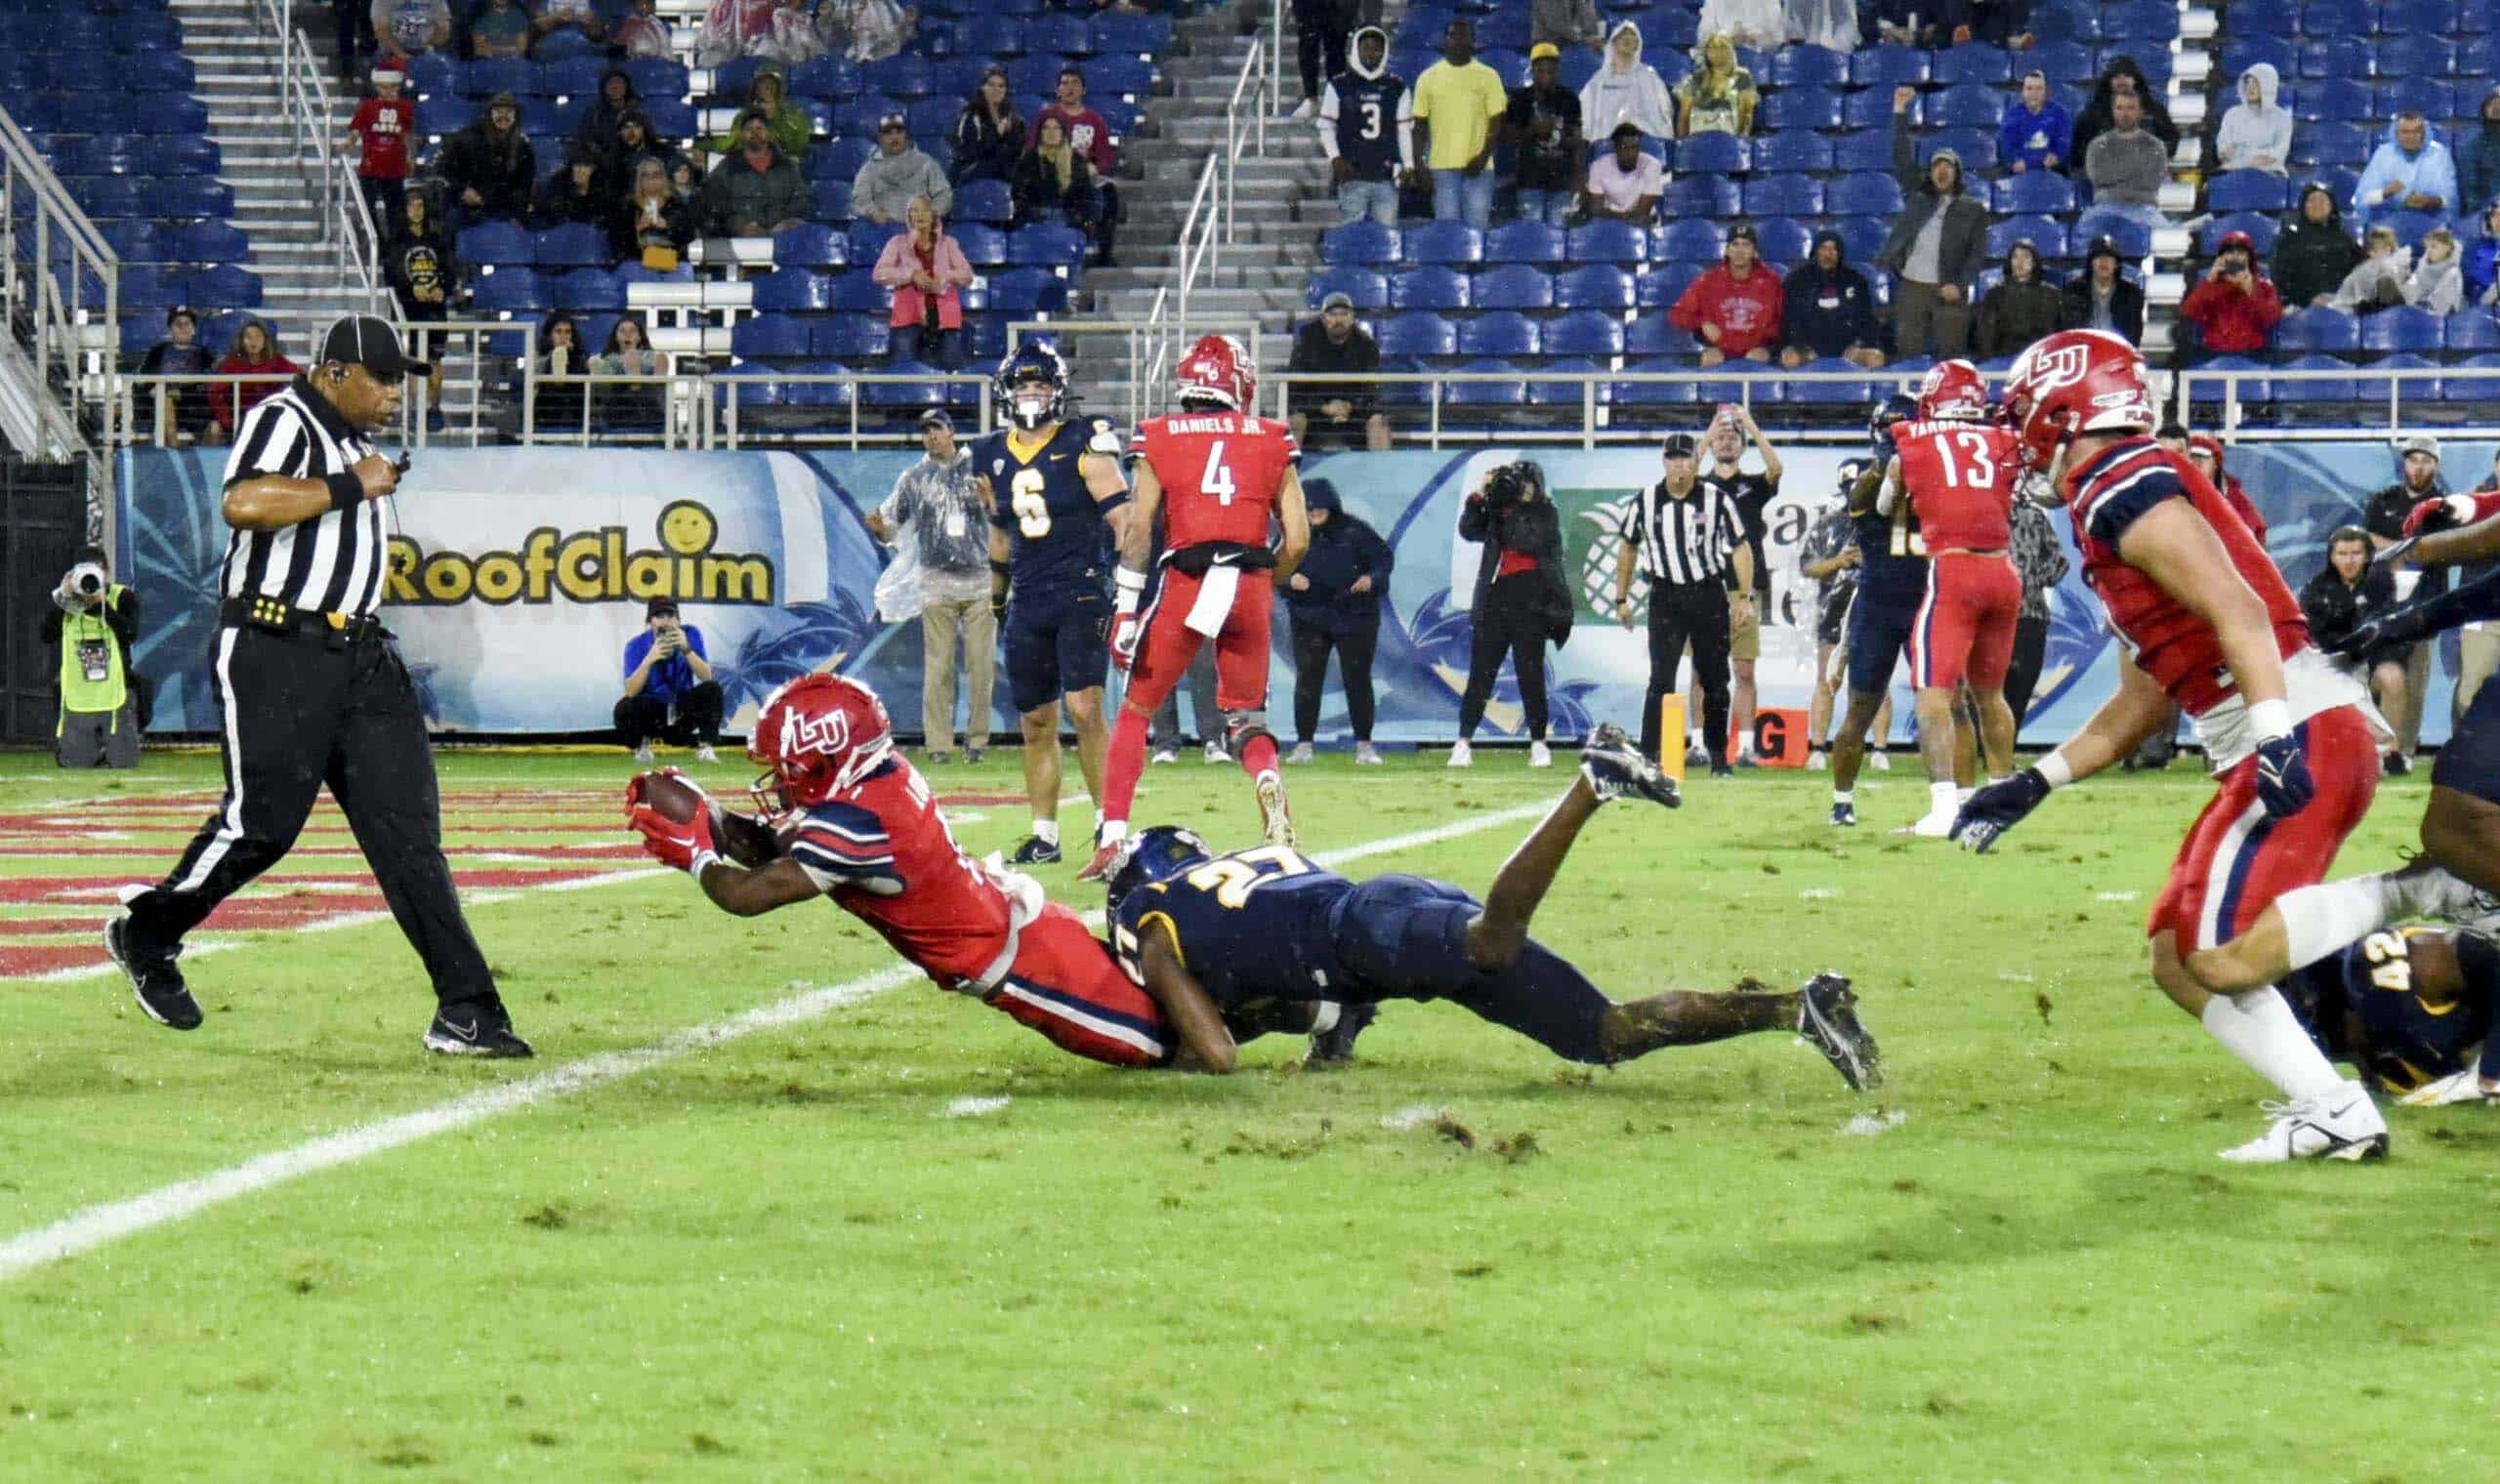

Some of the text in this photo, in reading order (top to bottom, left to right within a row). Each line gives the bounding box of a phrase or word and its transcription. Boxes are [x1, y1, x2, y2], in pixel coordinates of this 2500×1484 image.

[1360, 103, 1381, 140] 3
[2025, 343, 2090, 388] LU
[1168, 419, 1267, 434] DANIELS JR.
[1200, 440, 1236, 507] 4
[1935, 433, 1995, 488] 13
[1012, 468, 1052, 537] 6
[381, 500, 775, 606] RoofClaim
[792, 709, 850, 755] LU
[1754, 712, 1786, 761] G
[1188, 845, 1310, 910] 27
[2365, 930, 2411, 991] 42
